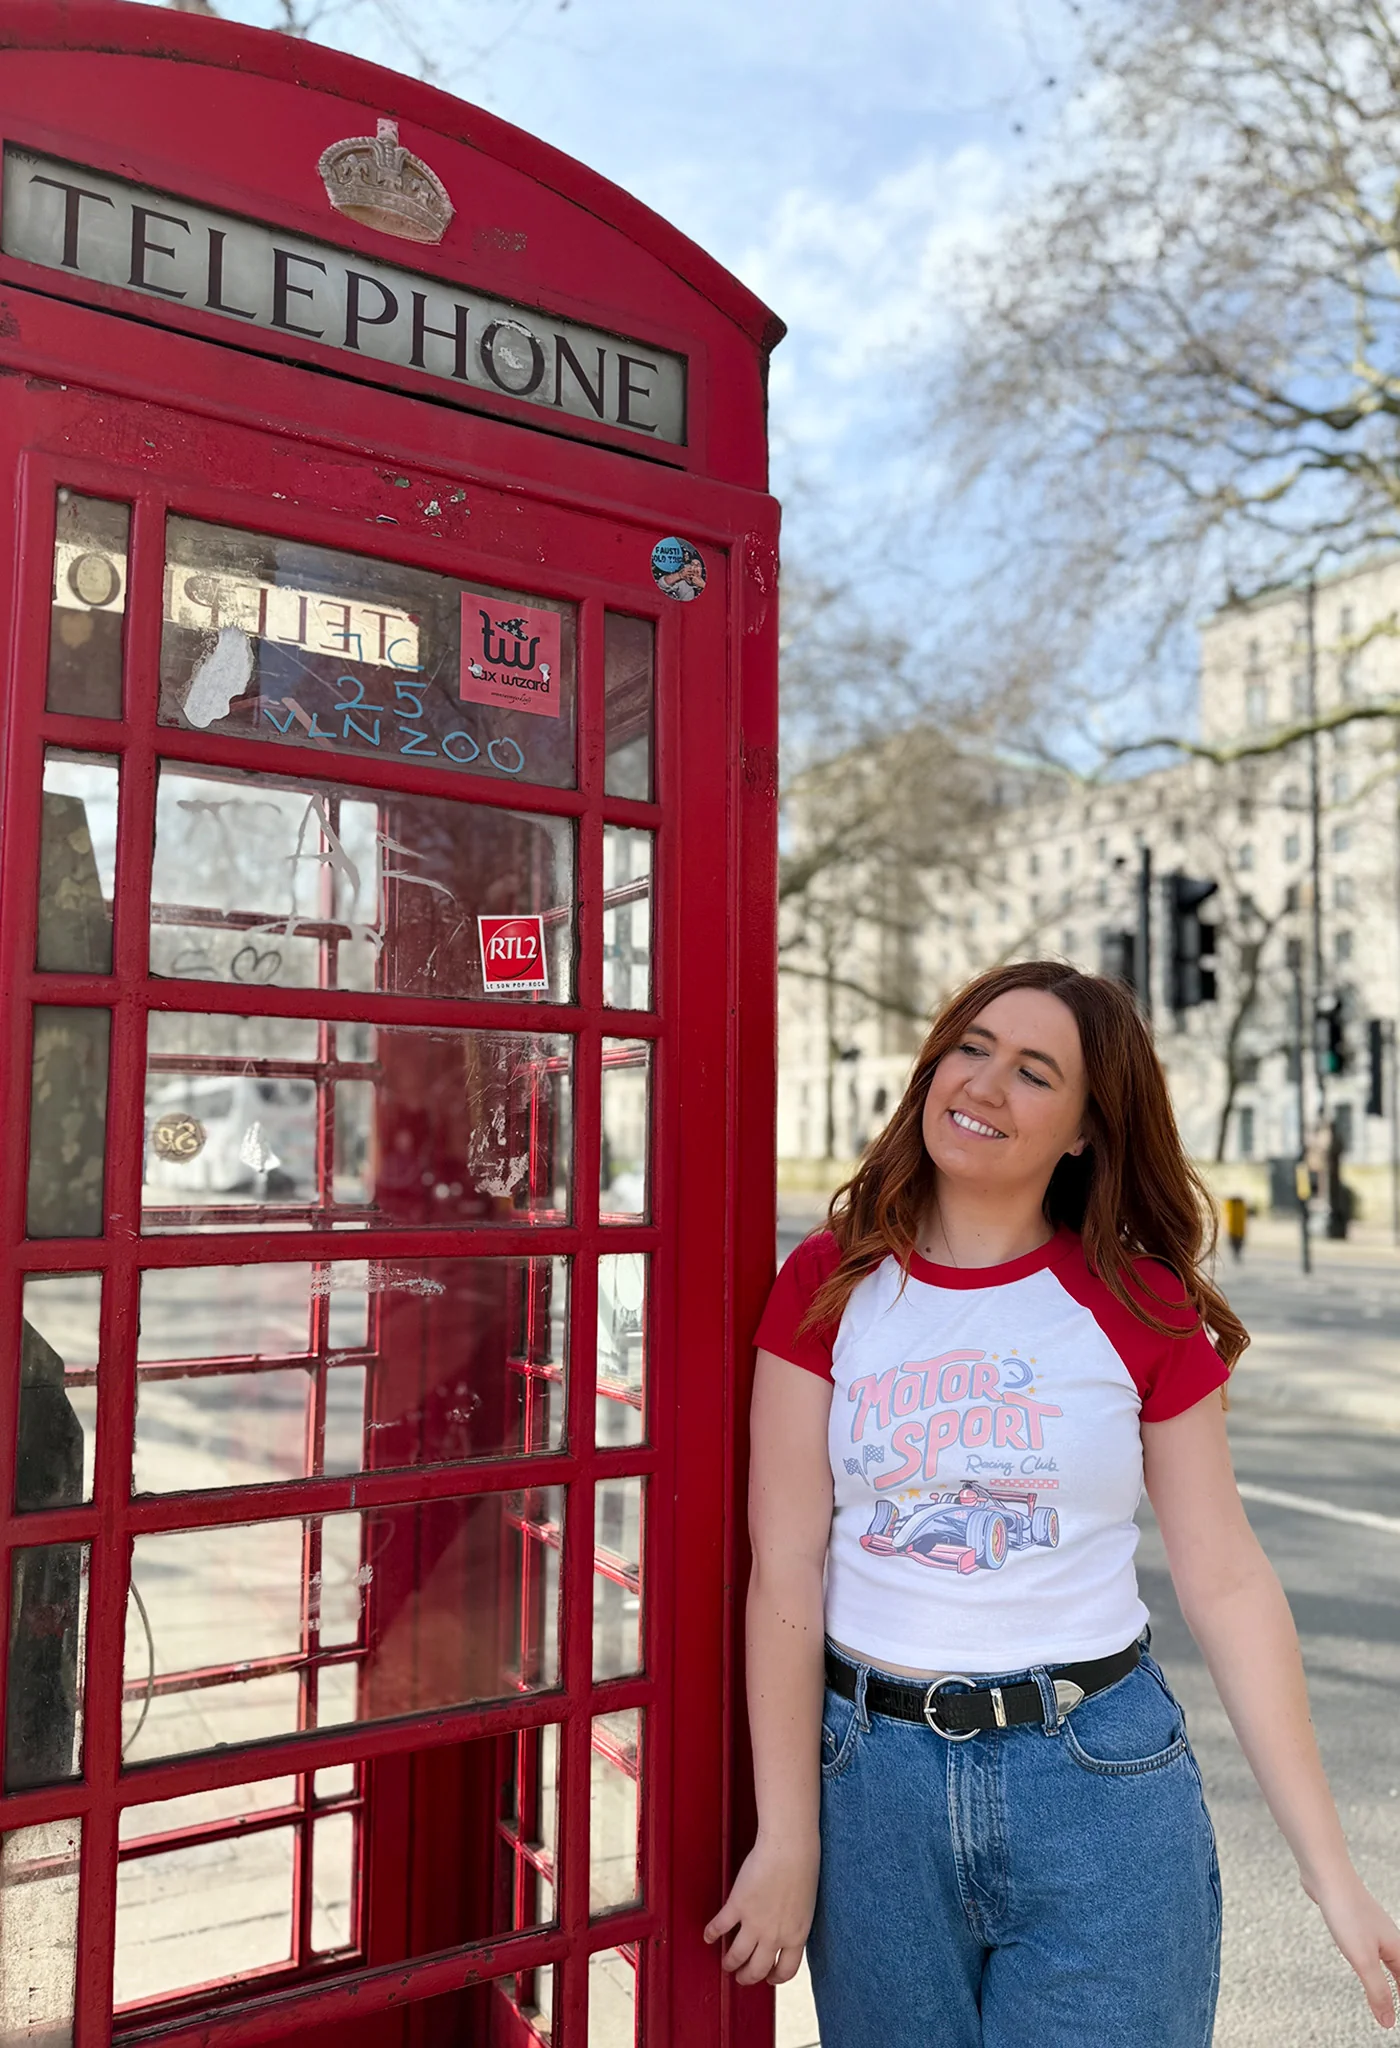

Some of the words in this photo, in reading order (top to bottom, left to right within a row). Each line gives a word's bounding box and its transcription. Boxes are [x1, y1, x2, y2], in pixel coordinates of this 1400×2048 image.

[29, 174, 659, 433] TELEPHONE
[490, 936, 538, 960] RTL2
[848, 1349, 1004, 1443] MOTOR
[874, 1391, 1064, 1491] SPORT
[965, 1454, 1015, 1476] Racing
[1020, 1455, 1060, 1475] Club
